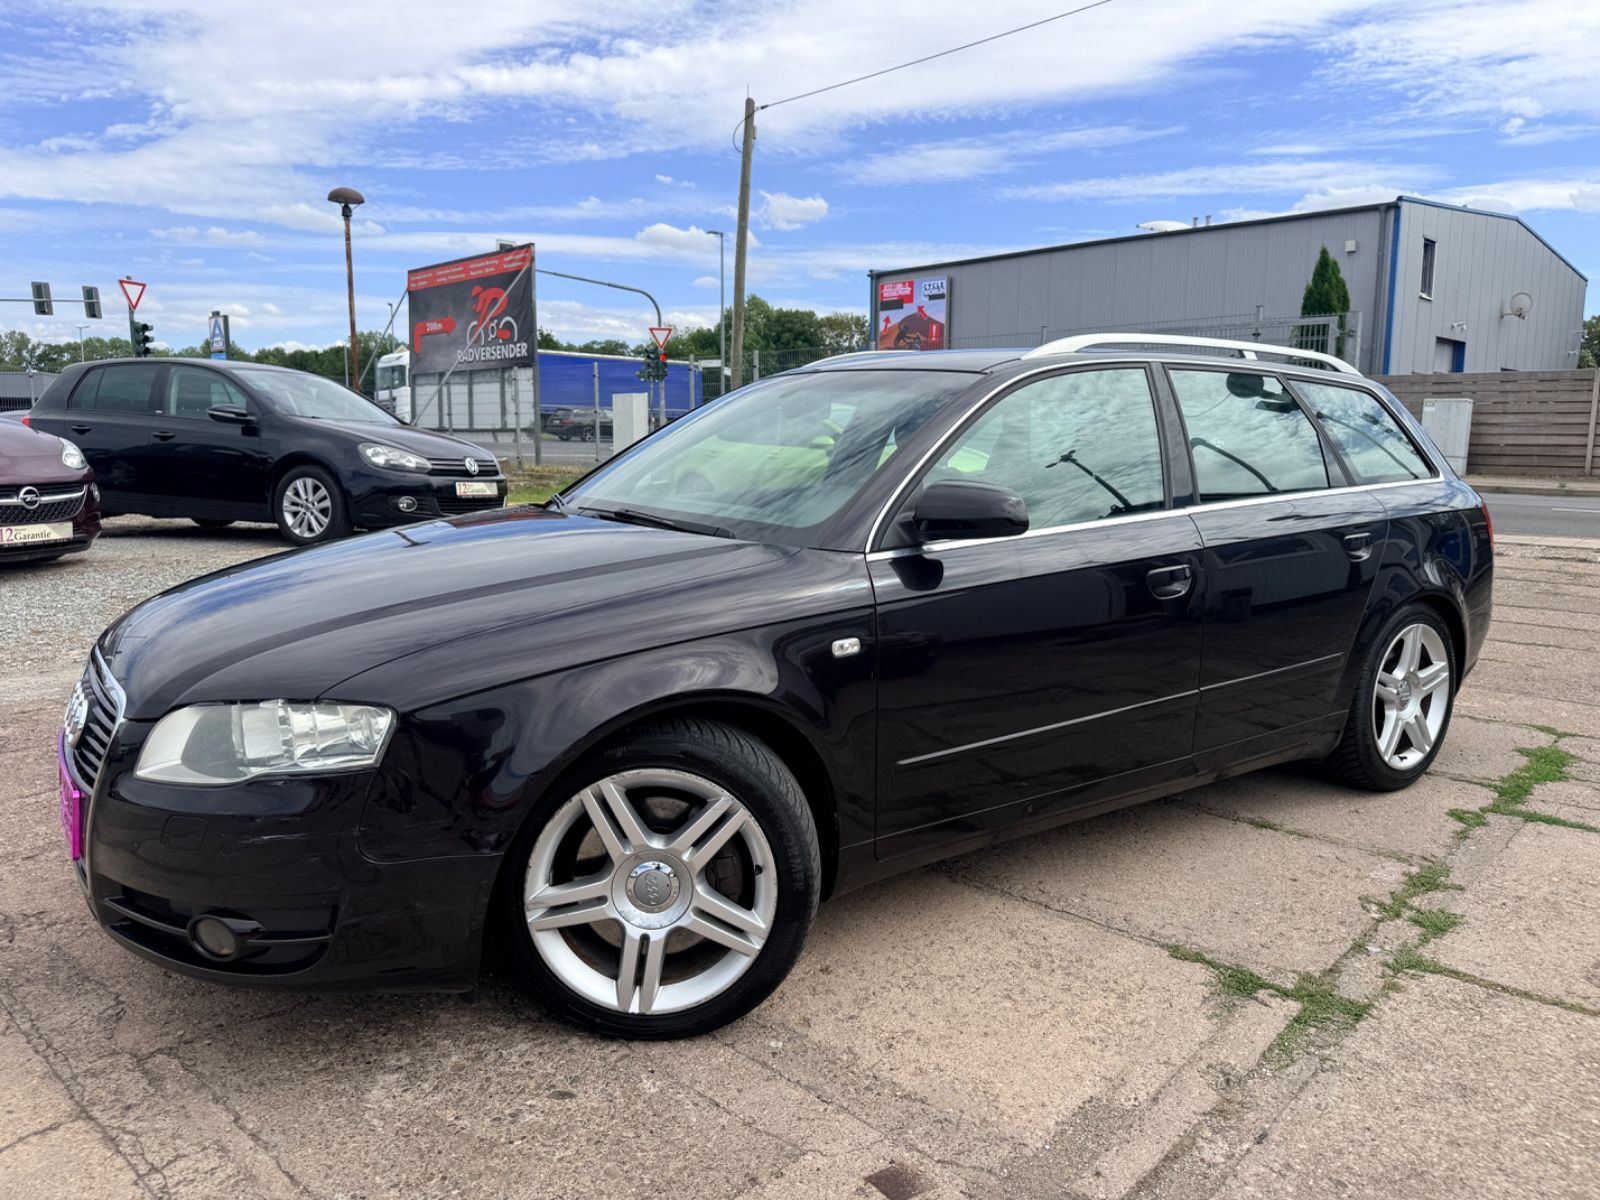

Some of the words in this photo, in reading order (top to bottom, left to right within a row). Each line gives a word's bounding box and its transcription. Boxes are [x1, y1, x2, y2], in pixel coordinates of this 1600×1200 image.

[457, 343, 528, 362] RADVERSENDER
[457, 483, 467, 494] 12
[0, 527, 14, 542] 12
[14, 530, 51, 540] Garantie
